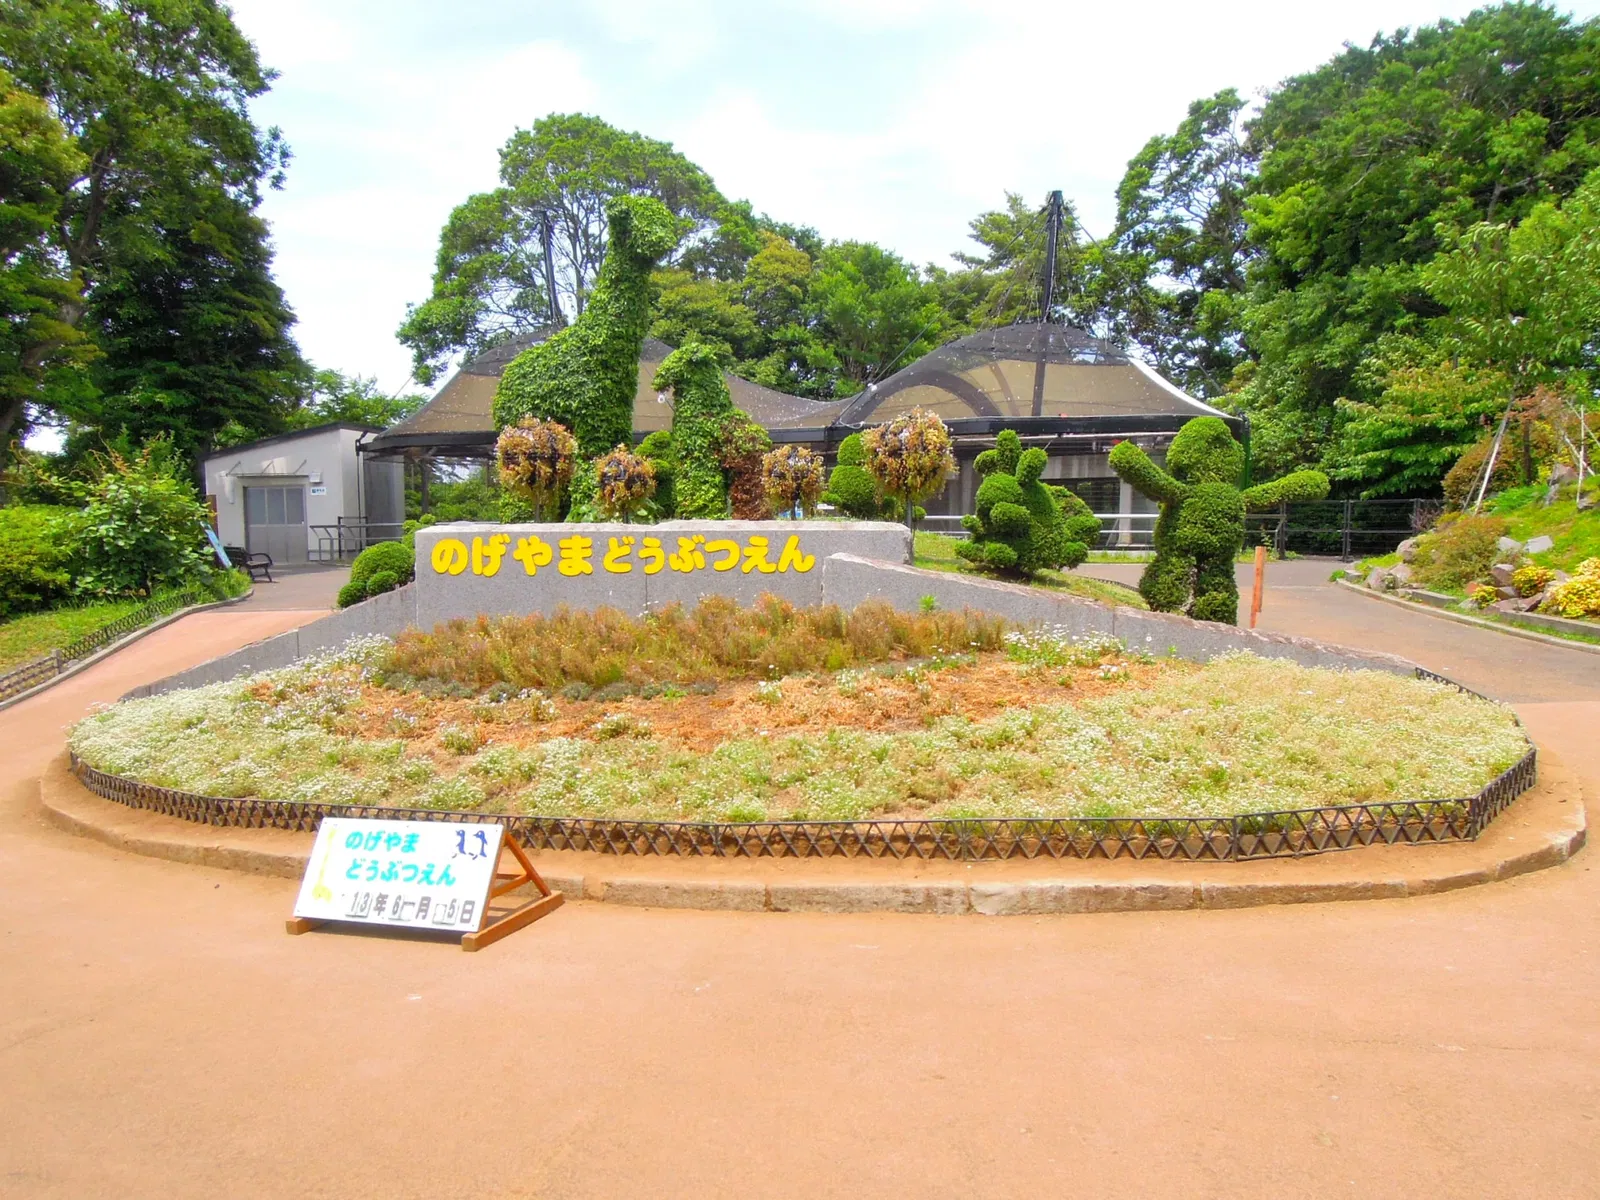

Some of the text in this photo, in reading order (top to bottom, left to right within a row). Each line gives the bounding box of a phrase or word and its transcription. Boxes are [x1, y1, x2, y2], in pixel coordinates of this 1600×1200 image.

[345, 830, 420, 853] のげやま
[345, 858, 456, 887] どうぶつえん
